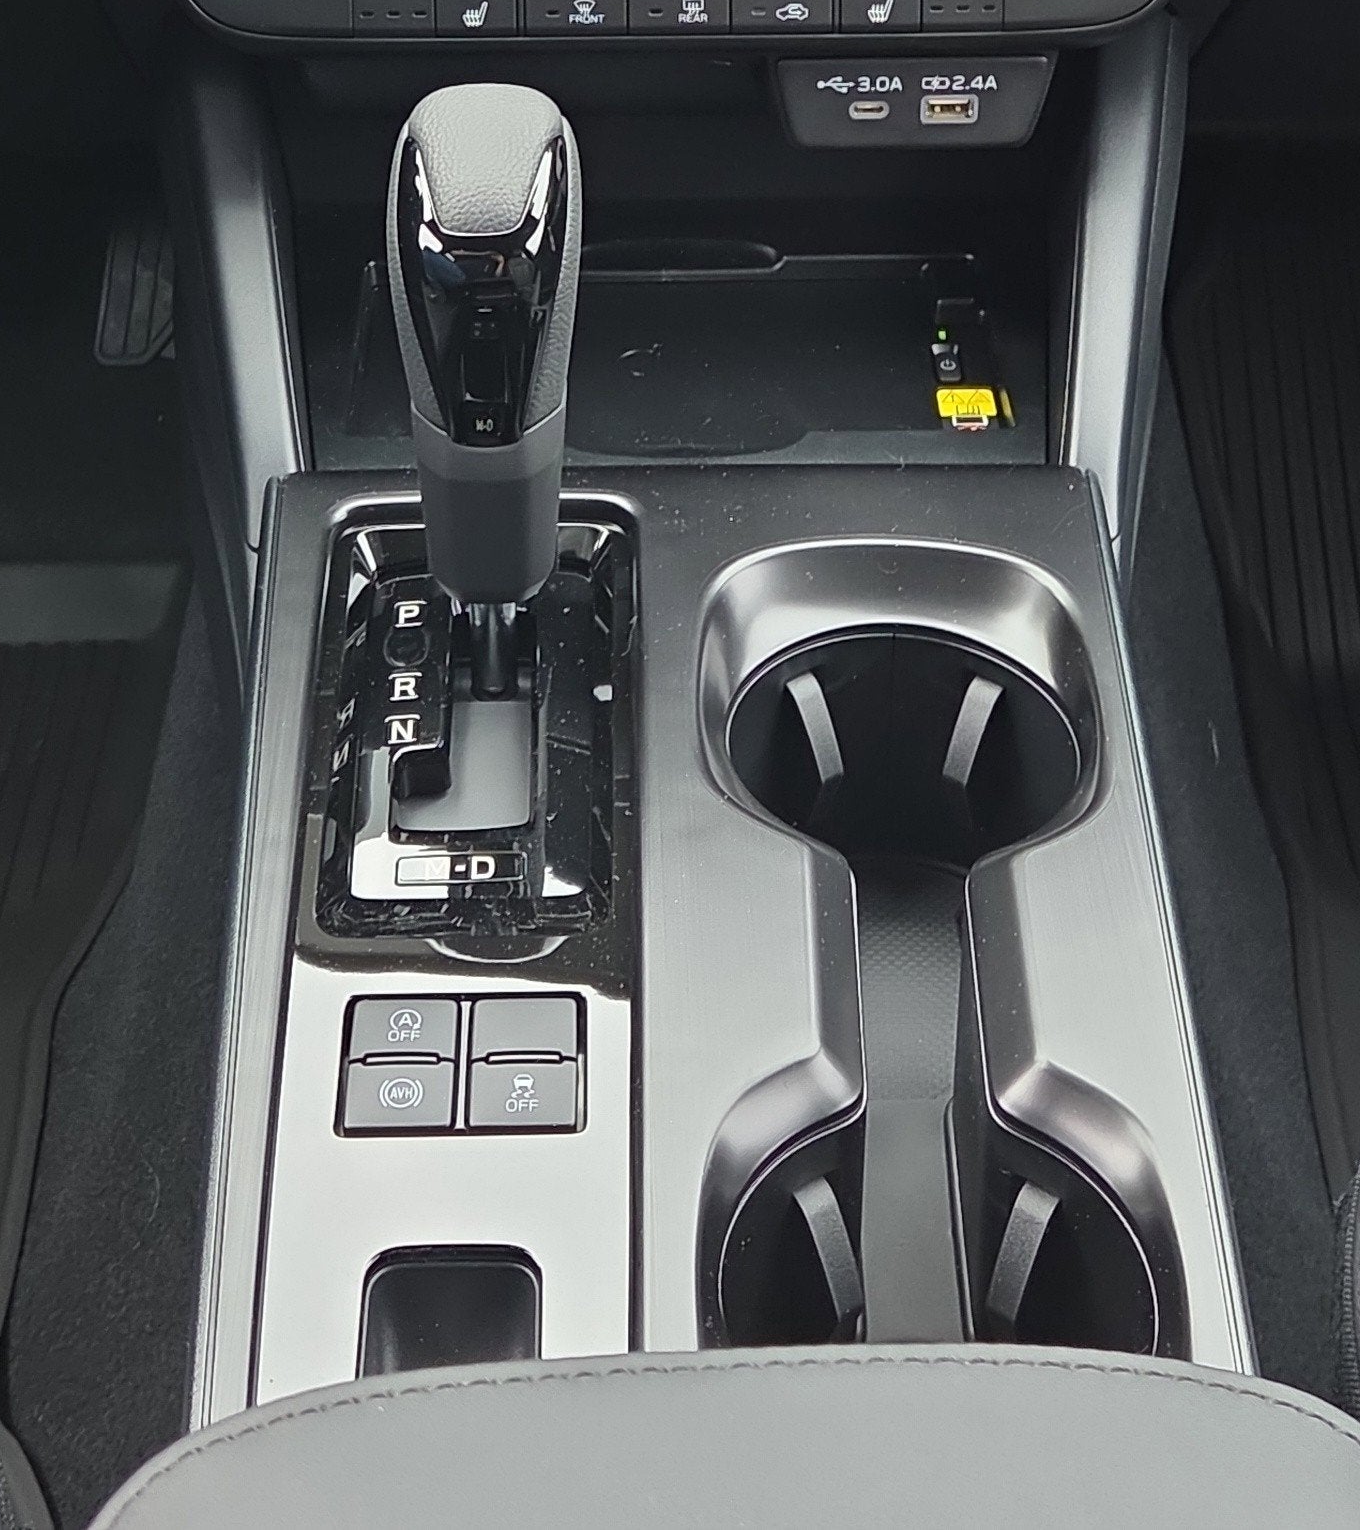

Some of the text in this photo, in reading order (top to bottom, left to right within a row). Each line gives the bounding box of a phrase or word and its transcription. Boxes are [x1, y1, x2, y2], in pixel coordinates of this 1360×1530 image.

[568, 13, 605, 24] FRONT
[678, 12, 709, 23] REAR
[856, 74, 998, 93] 3.0A 2.4A
[398, 605, 420, 624] P
[394, 676, 416, 697] R
[390, 720, 414, 740] N
[387, 1029, 422, 1043] OFF
[390, 1087, 414, 1099] AVH
[505, 1099, 539, 1113] OFF
